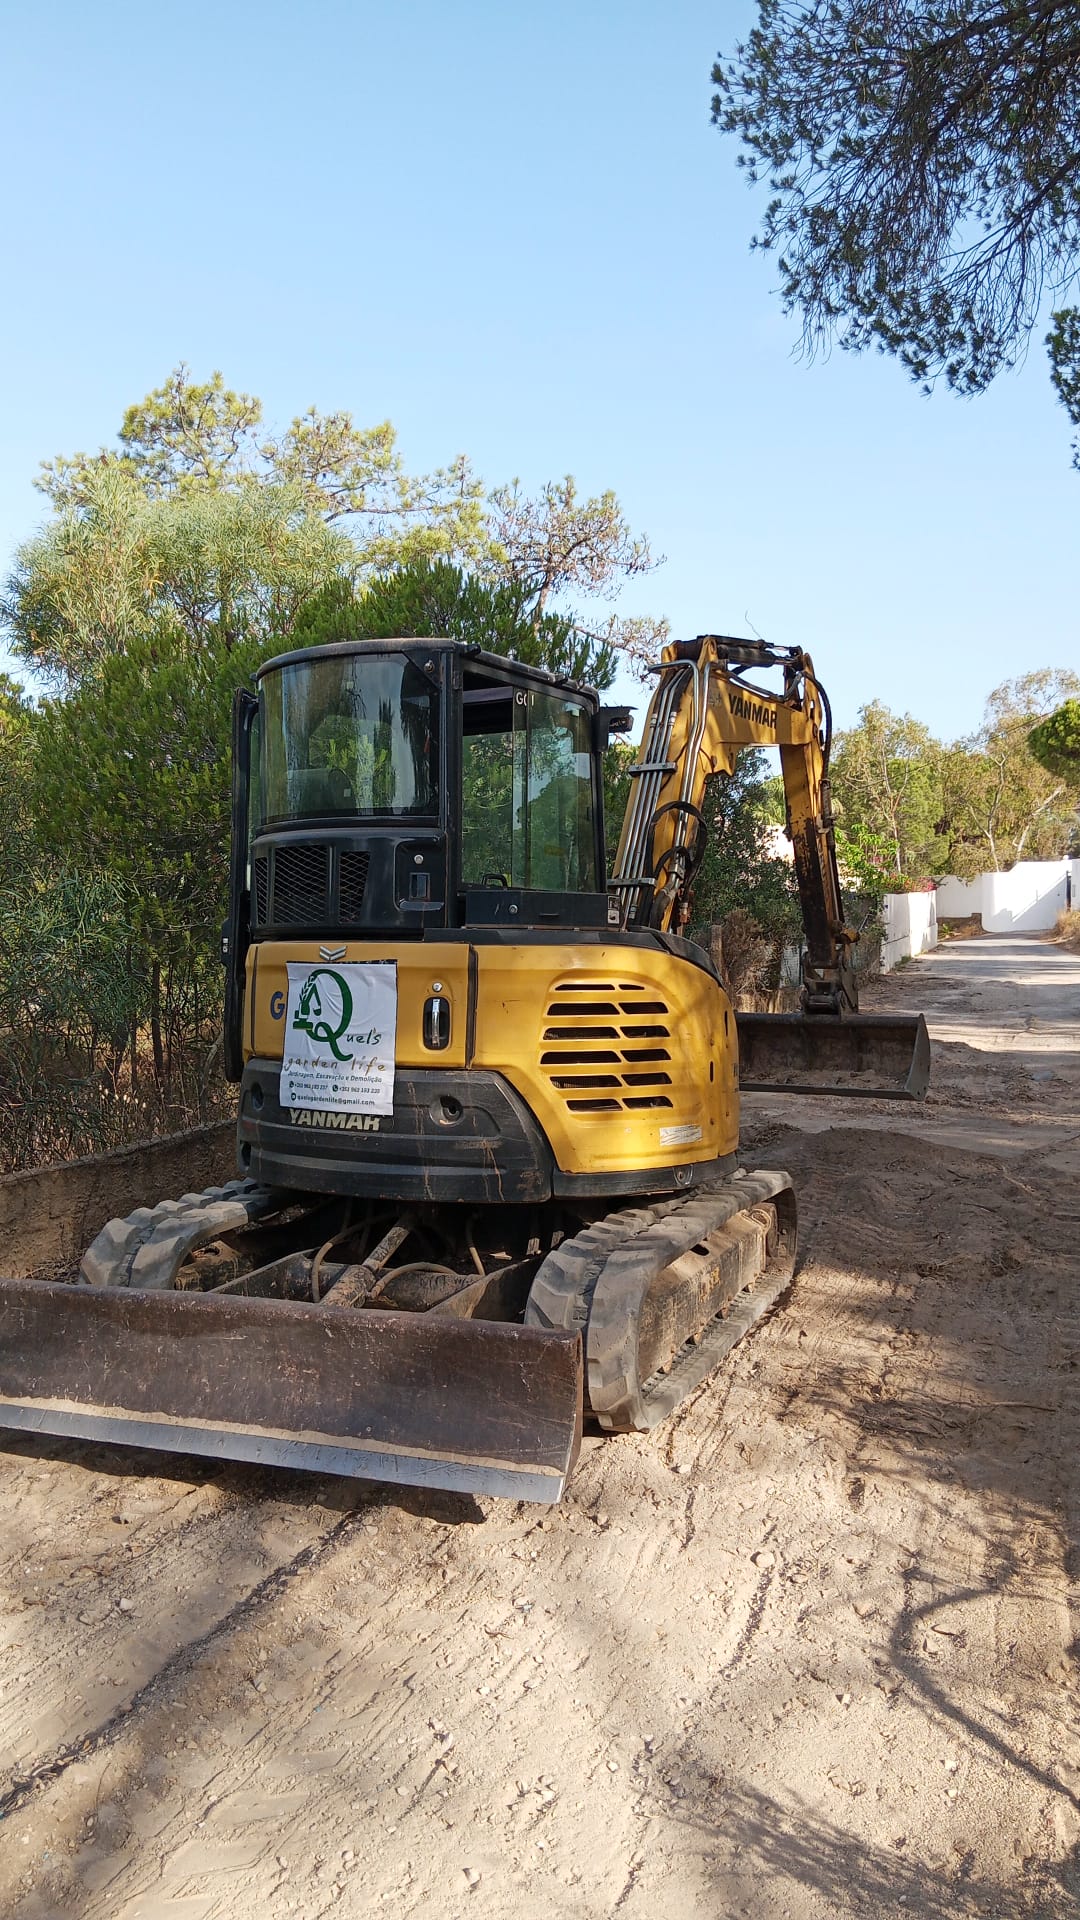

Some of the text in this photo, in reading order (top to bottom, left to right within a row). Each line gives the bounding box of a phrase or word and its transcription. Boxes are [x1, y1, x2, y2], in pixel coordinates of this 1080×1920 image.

[728, 693, 778, 730] YANMAR
[284, 1056, 386, 1076] garden life
[289, 1108, 380, 1131] YANMAR
